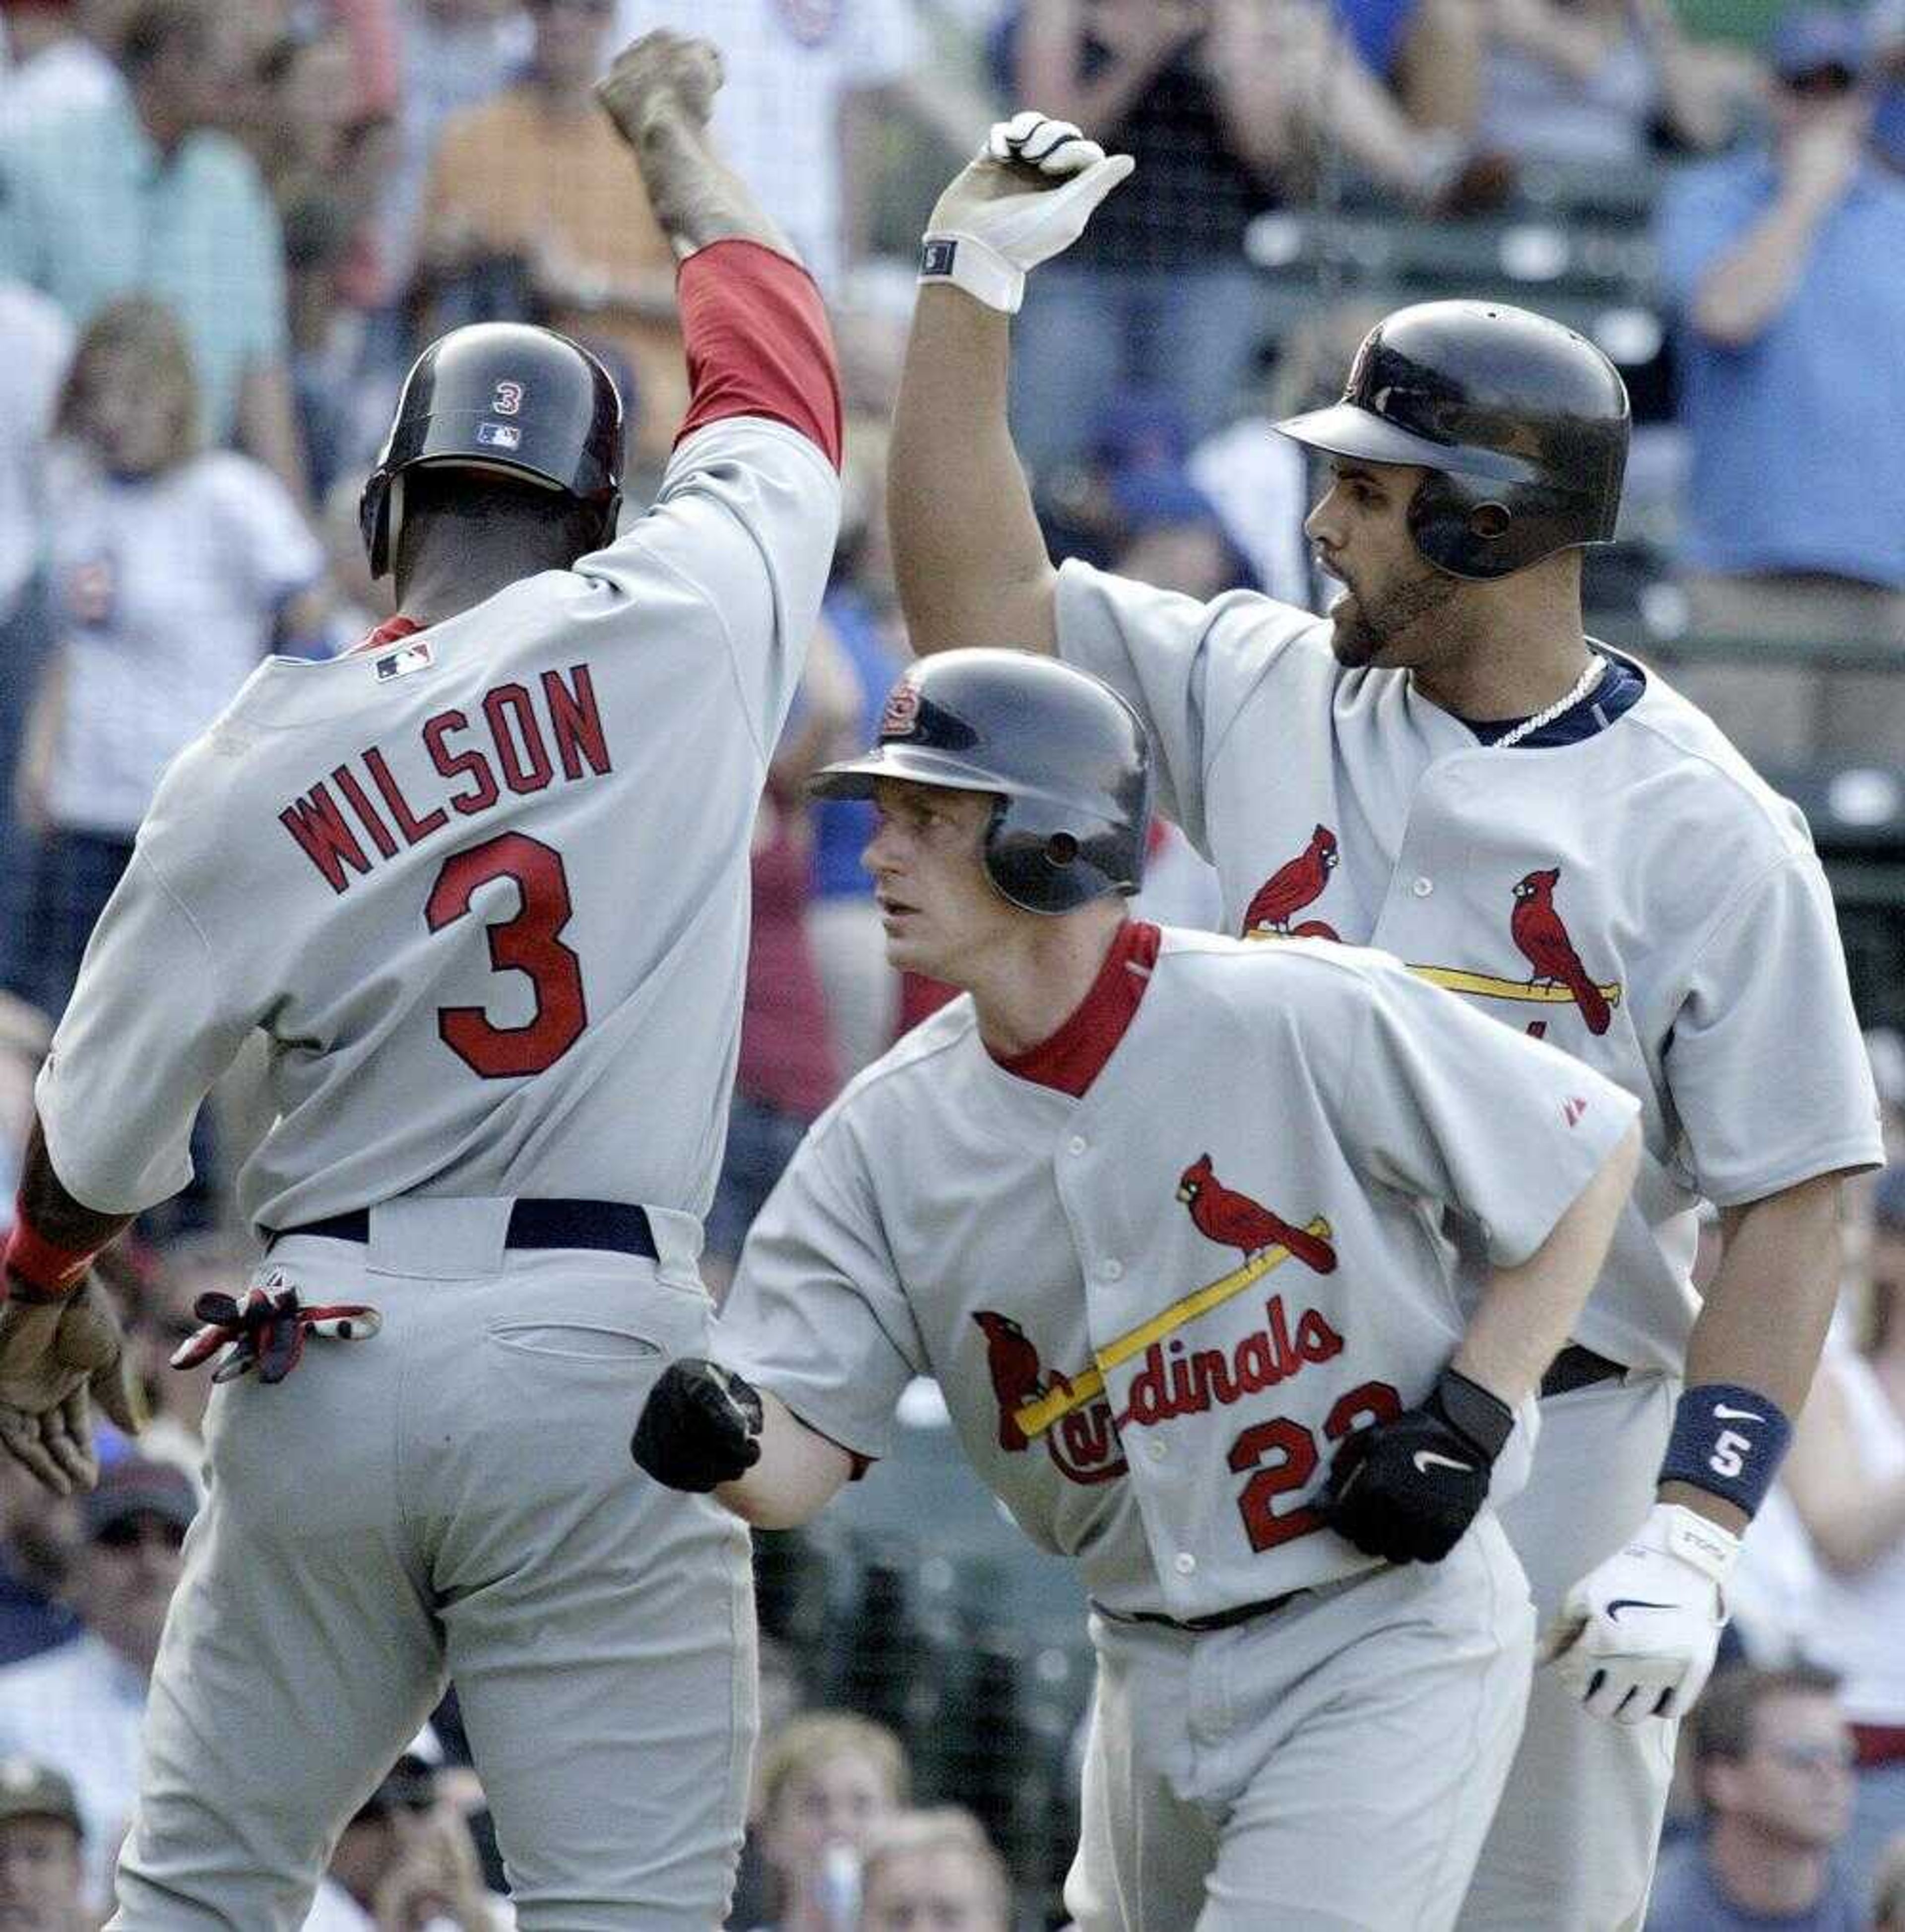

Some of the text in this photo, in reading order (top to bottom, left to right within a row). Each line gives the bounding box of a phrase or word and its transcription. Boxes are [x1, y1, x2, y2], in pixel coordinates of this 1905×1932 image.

[493, 382, 521, 415] 3
[278, 664, 612, 895] WILSON
[424, 830, 587, 1079] 3
[1710, 1429, 1752, 1477] 5
